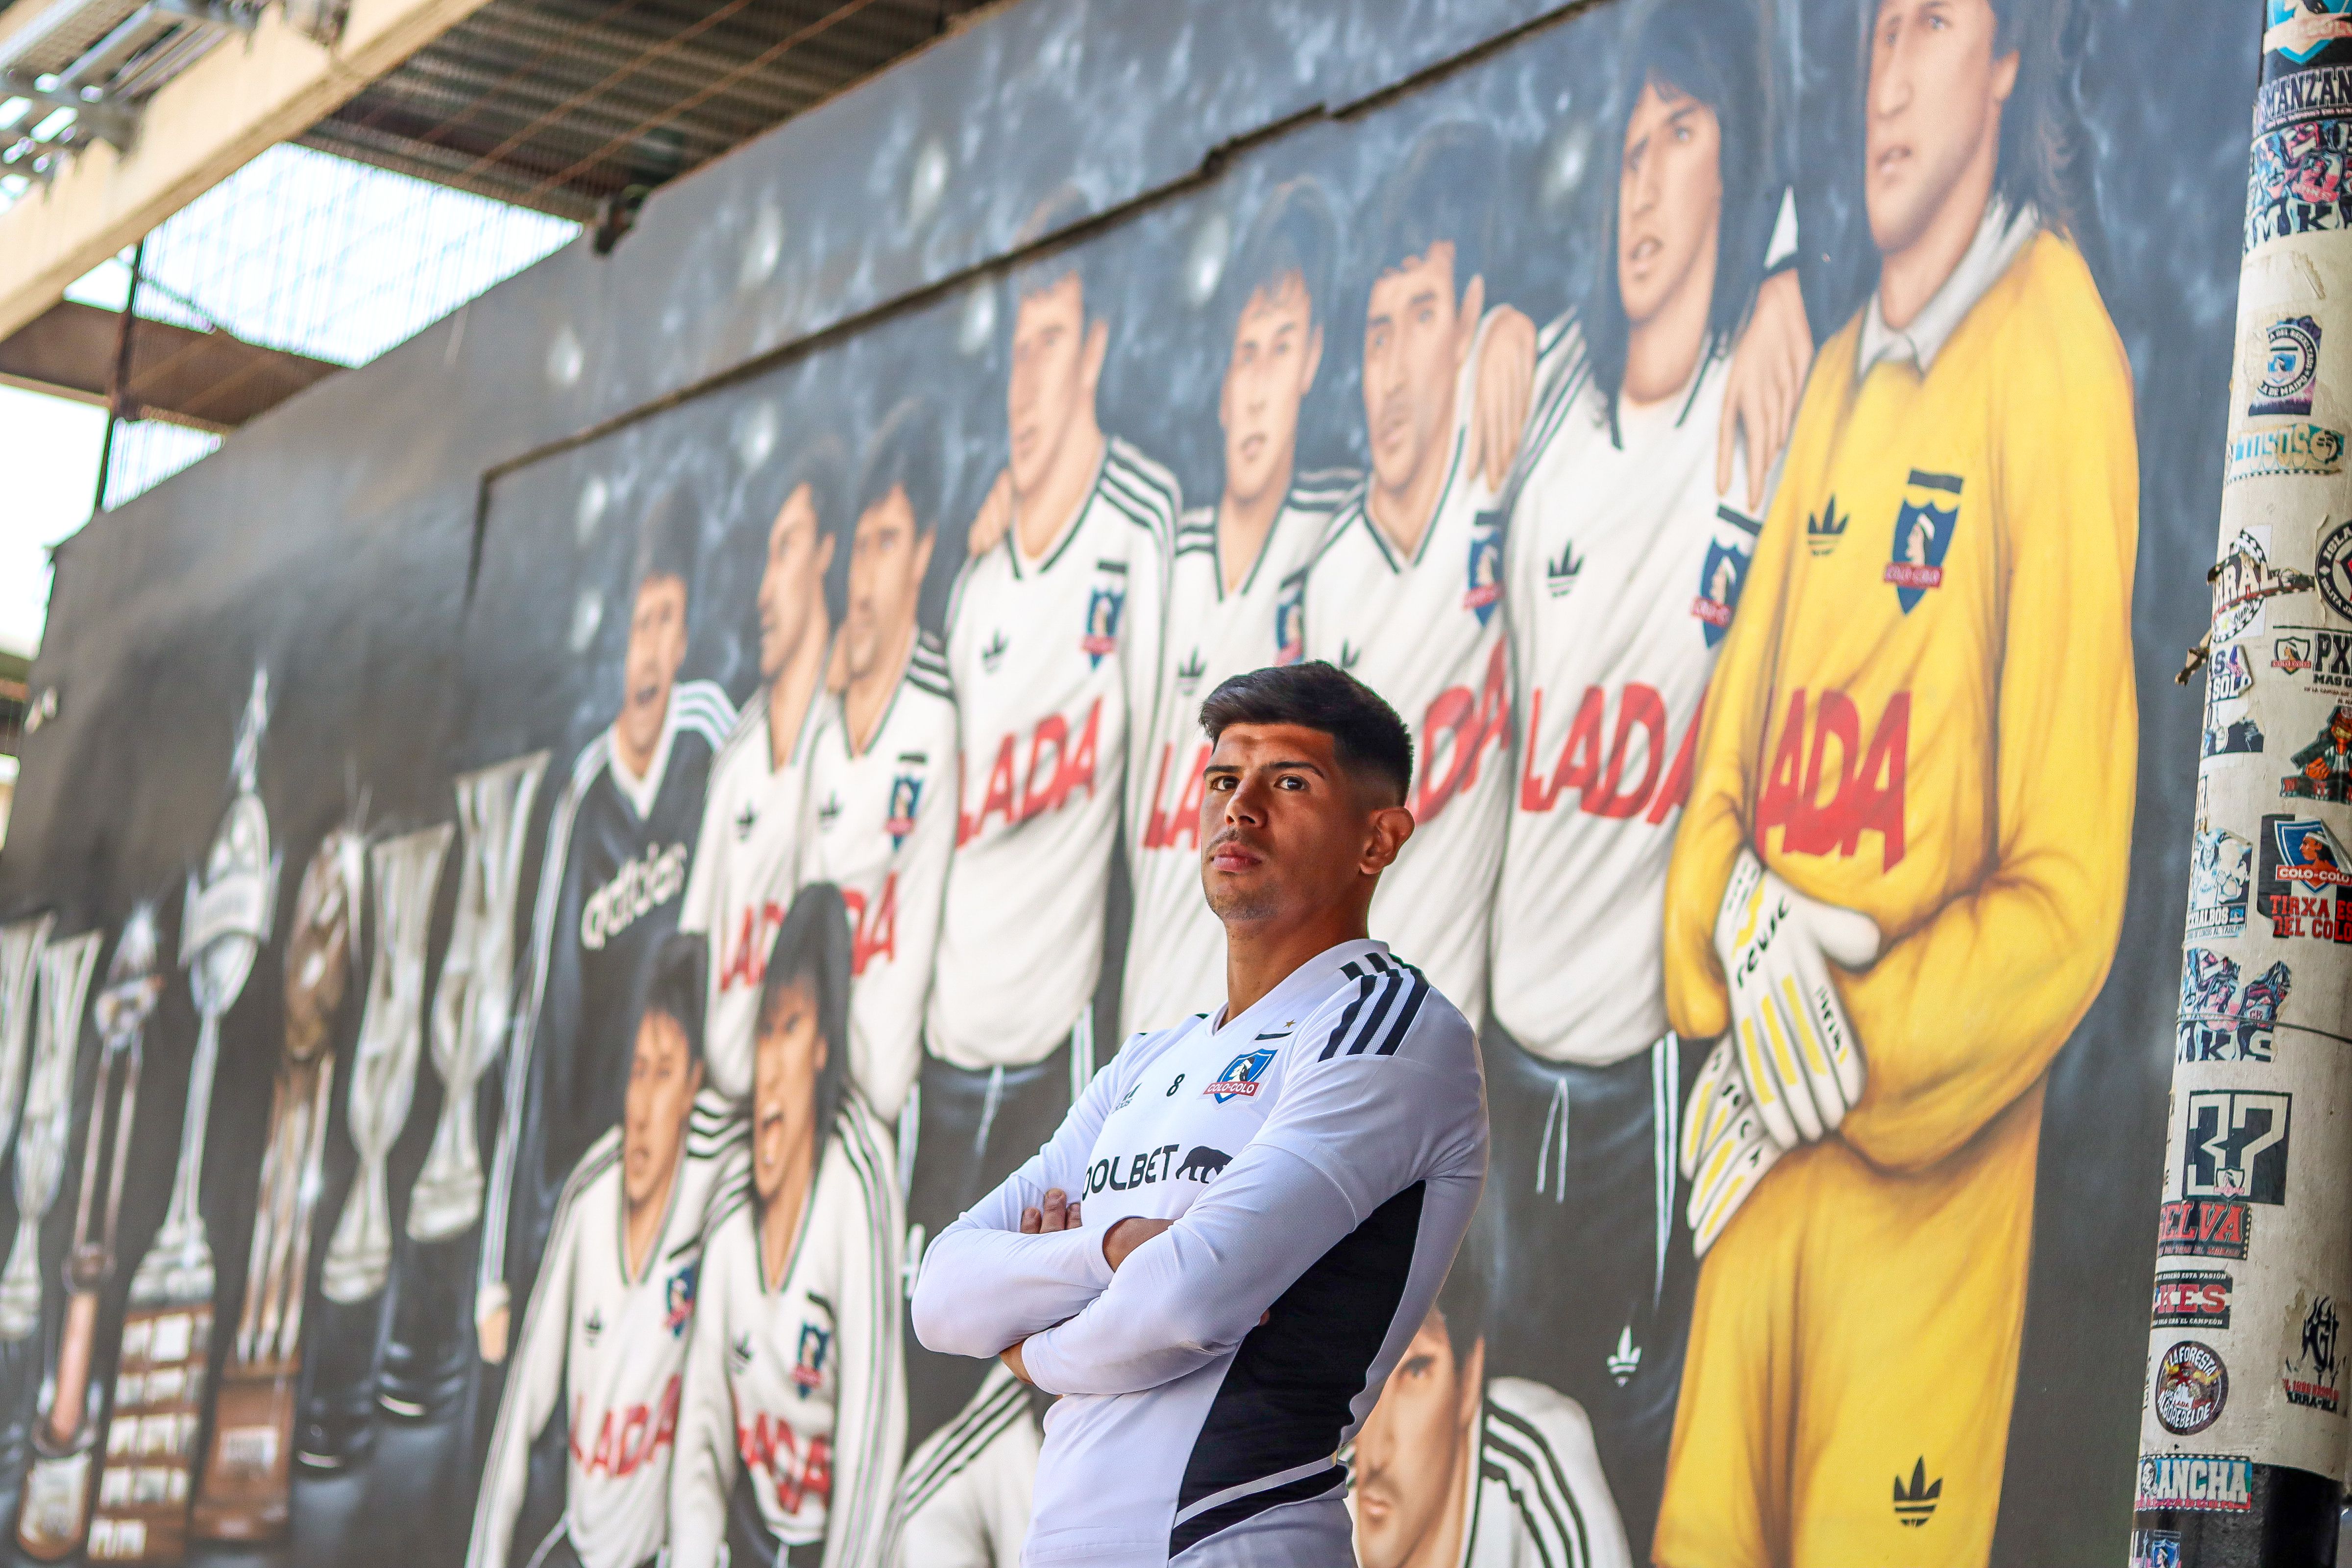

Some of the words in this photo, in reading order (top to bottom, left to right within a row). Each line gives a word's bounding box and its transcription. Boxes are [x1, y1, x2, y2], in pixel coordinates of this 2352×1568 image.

[2279, 867, 2350, 883] COLO-COLO
[2270, 895, 2330, 918] TIRXA
[2272, 915, 2305, 936] DEL
[1166, 1073, 1185, 1097] 8
[1207, 1082, 1255, 1094] COLO-COLO
[2186, 1093, 2289, 1197] 37
